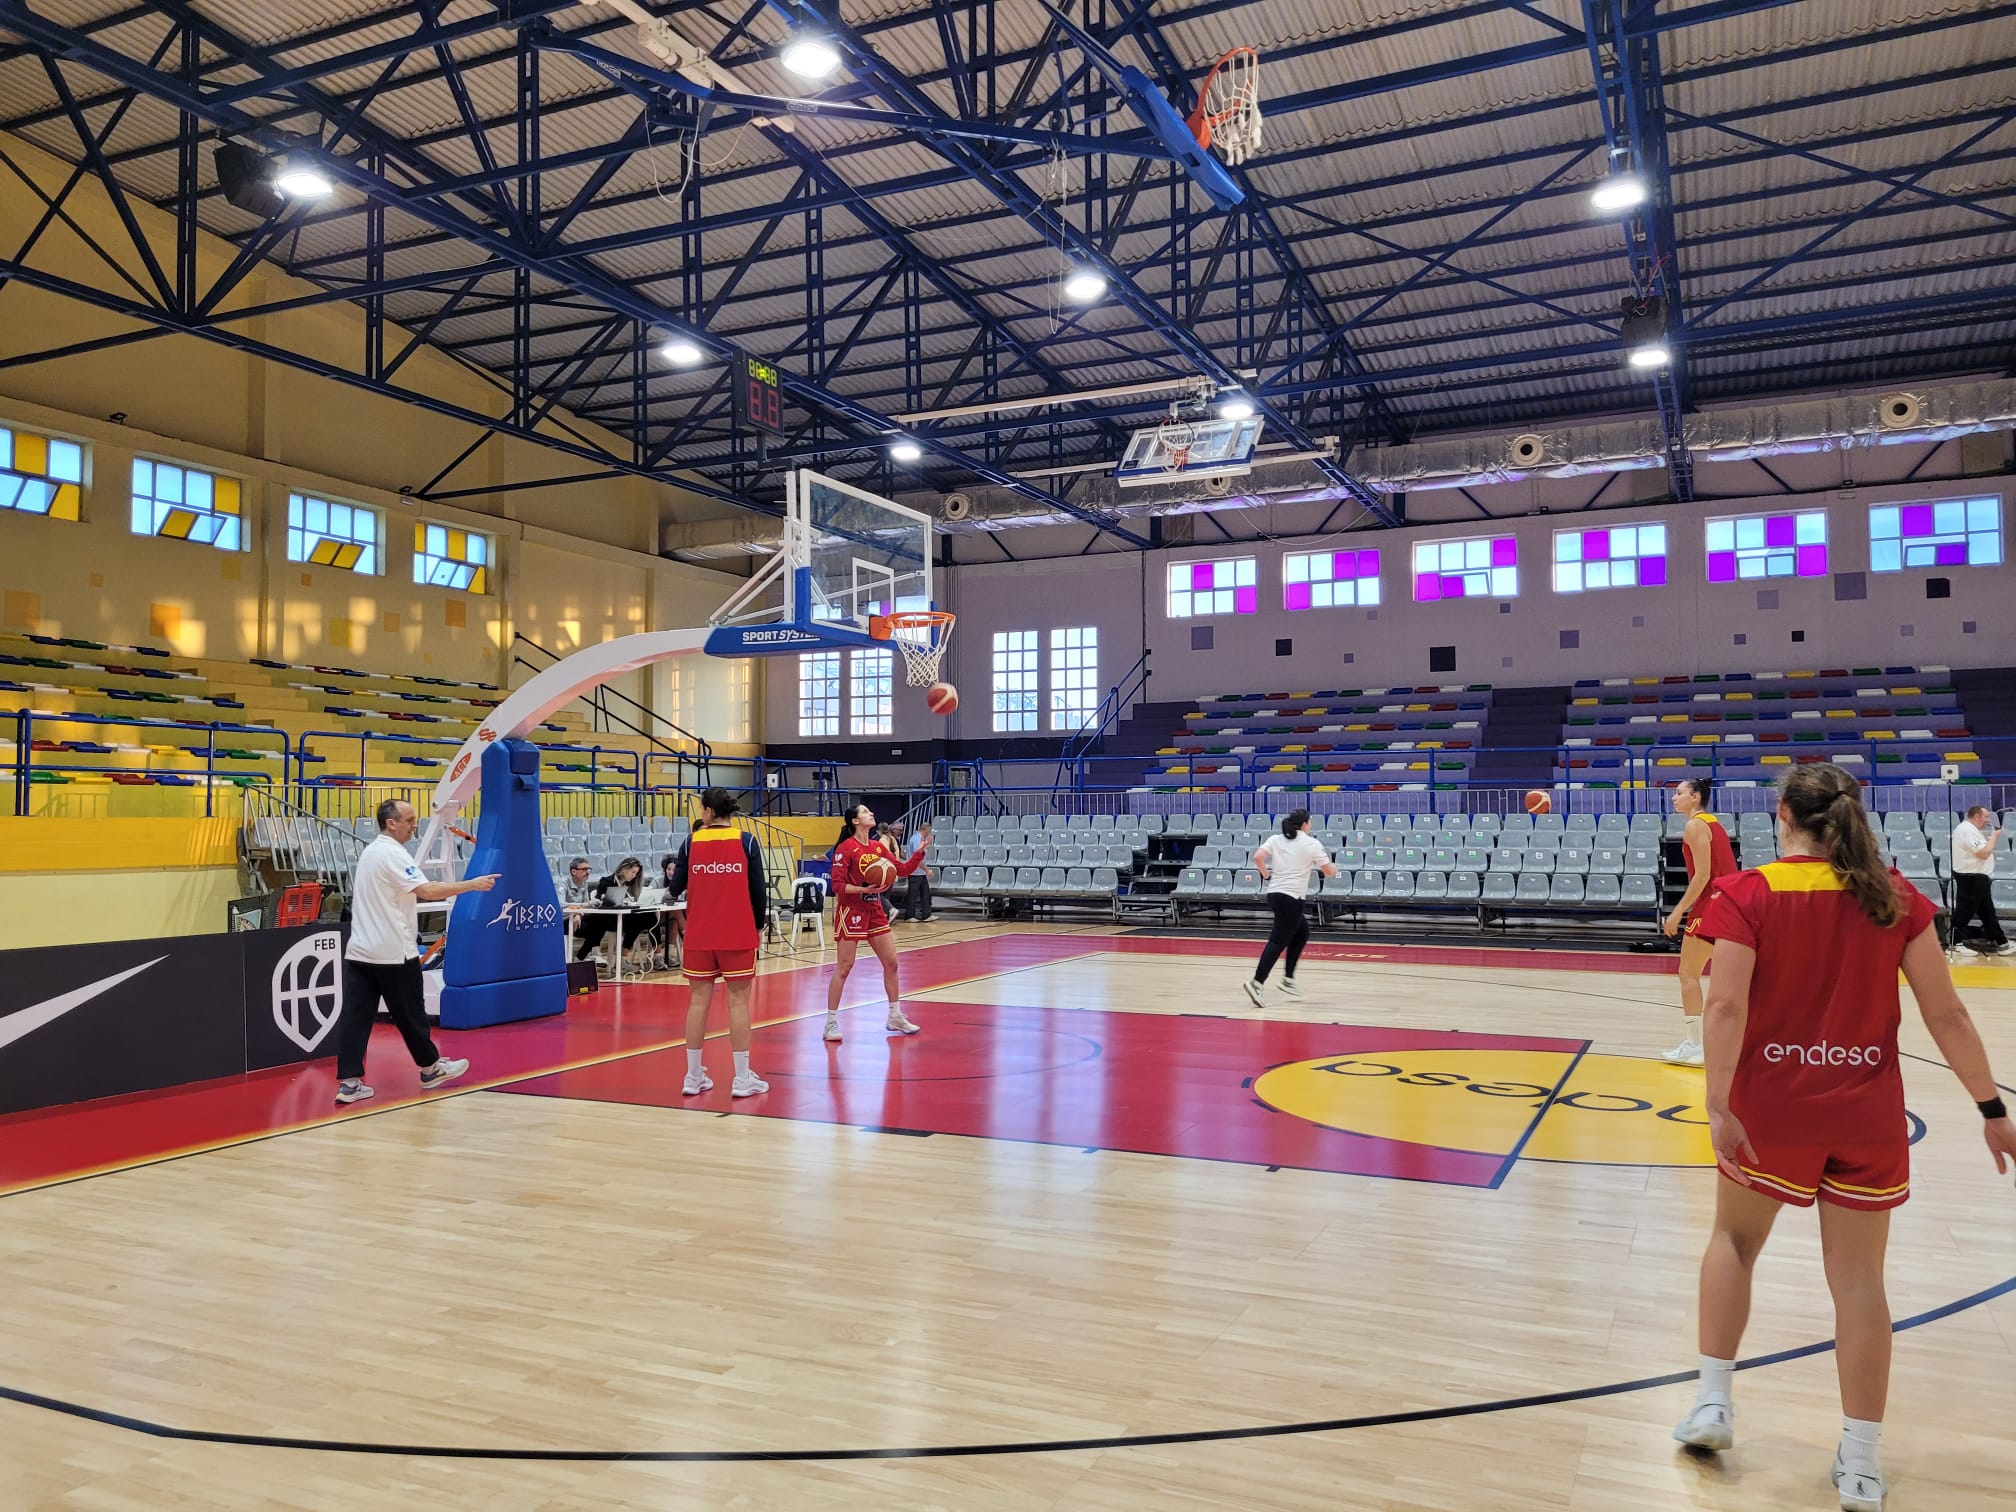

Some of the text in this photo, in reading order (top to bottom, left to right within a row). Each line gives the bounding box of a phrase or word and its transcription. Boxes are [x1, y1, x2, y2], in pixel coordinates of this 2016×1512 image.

[692, 860, 743, 875] endesa
[515, 903, 557, 925] IBERO
[515, 922, 557, 931] SPORT
[314, 937, 336, 951] FEB
[1763, 1039, 1882, 1067] endesa
